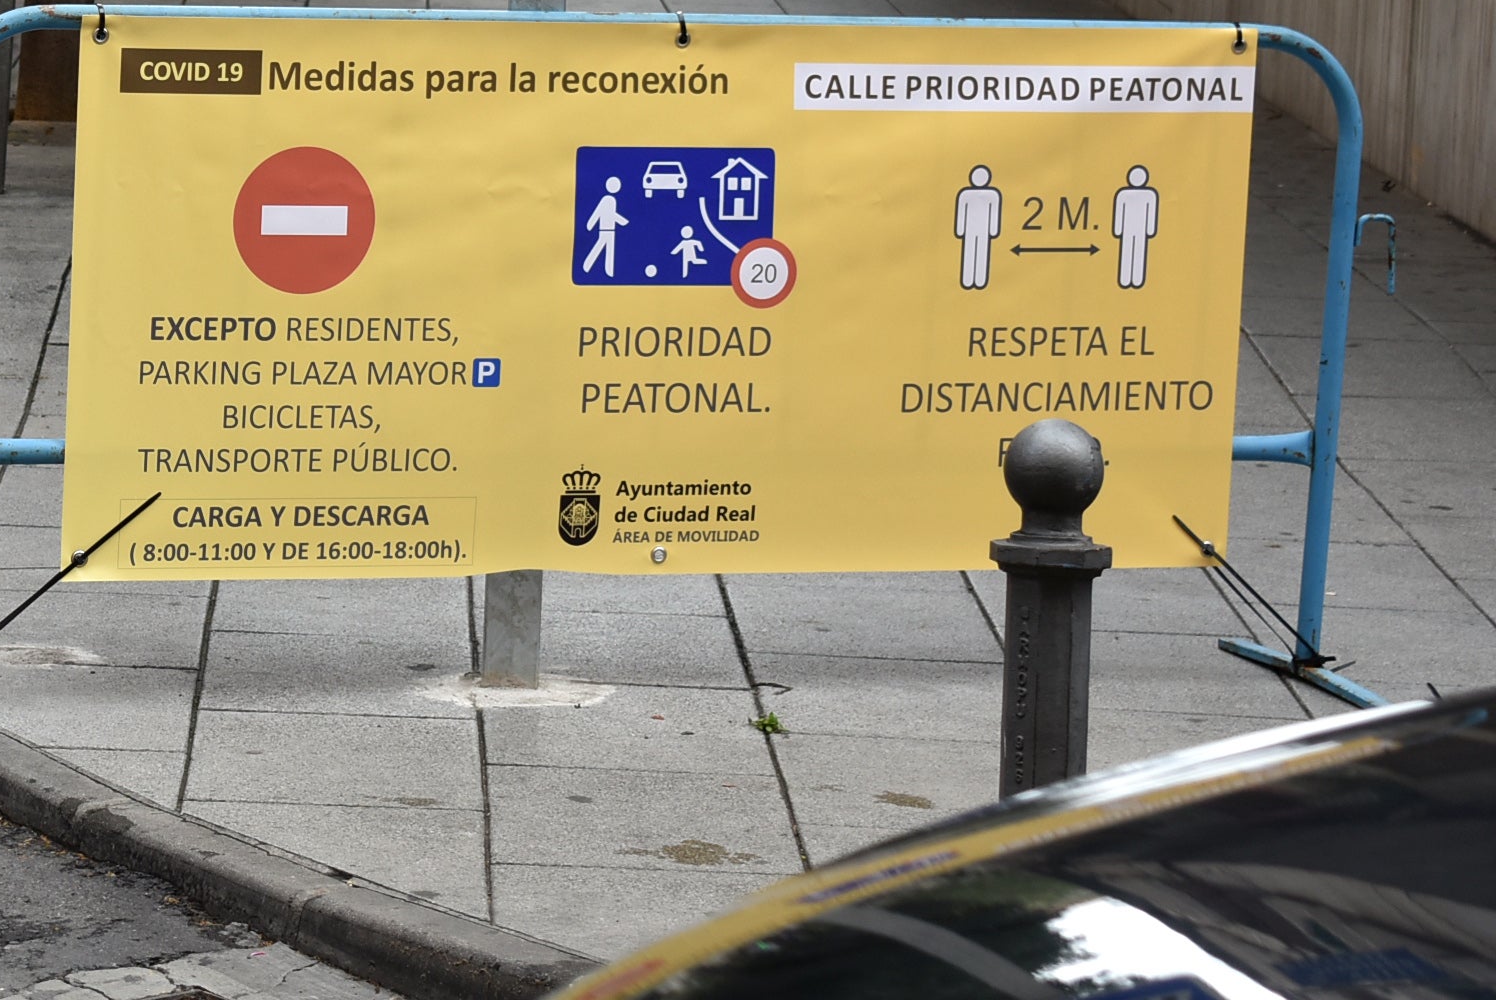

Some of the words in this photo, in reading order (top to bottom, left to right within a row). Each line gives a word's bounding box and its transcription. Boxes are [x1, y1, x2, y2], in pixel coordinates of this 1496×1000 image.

[139, 61, 210, 82] COVID
[217, 62, 244, 83] 19
[268, 60, 414, 92] Medidas
[425, 68, 498, 99] para
[509, 62, 537, 93] la
[547, 63, 730, 94] reconexión
[804, 74, 897, 100] CALLE
[905, 75, 1081, 101] PRIORIDAD
[1089, 77, 1244, 102] PEATONAL
[1021, 196, 1045, 231] 2
[1056, 196, 1100, 231] M.
[750, 263, 777, 284] 20
[150, 316, 277, 342] EXCEPTO
[285, 317, 459, 346] RESIDENTES,
[577, 326, 773, 358] PRIORIDAD
[967, 326, 1108, 358] RESPETA
[1119, 325, 1156, 356] EL
[138, 360, 262, 386] PARKING
[271, 361, 358, 385] PLAZA
[366, 361, 468, 385] MAYOR
[477, 362, 496, 384] P
[580, 382, 771, 414] PEATONAL.
[900, 379, 1214, 414] DISTANCIAMIENTO
[222, 404, 382, 434] BICICLETAS,
[137, 447, 323, 473] TRANSPORTE
[332, 442, 459, 473] PÚBLICO.
[615, 479, 753, 500] Ayuntamiento
[172, 505, 264, 527] CARGA
[270, 506, 286, 527] Y
[292, 504, 430, 527] DESCARGA
[614, 505, 638, 523] de
[643, 505, 710, 523] Ciudad
[716, 505, 757, 522] Real
[612, 527, 650, 544] ÁREA
[655, 530, 674, 543] DE
[677, 529, 760, 543] MOVILIDAD
[262, 542, 276, 560] Y
[282, 541, 310, 561] DE
[315, 539, 468, 563] 16:00-18:00h).
